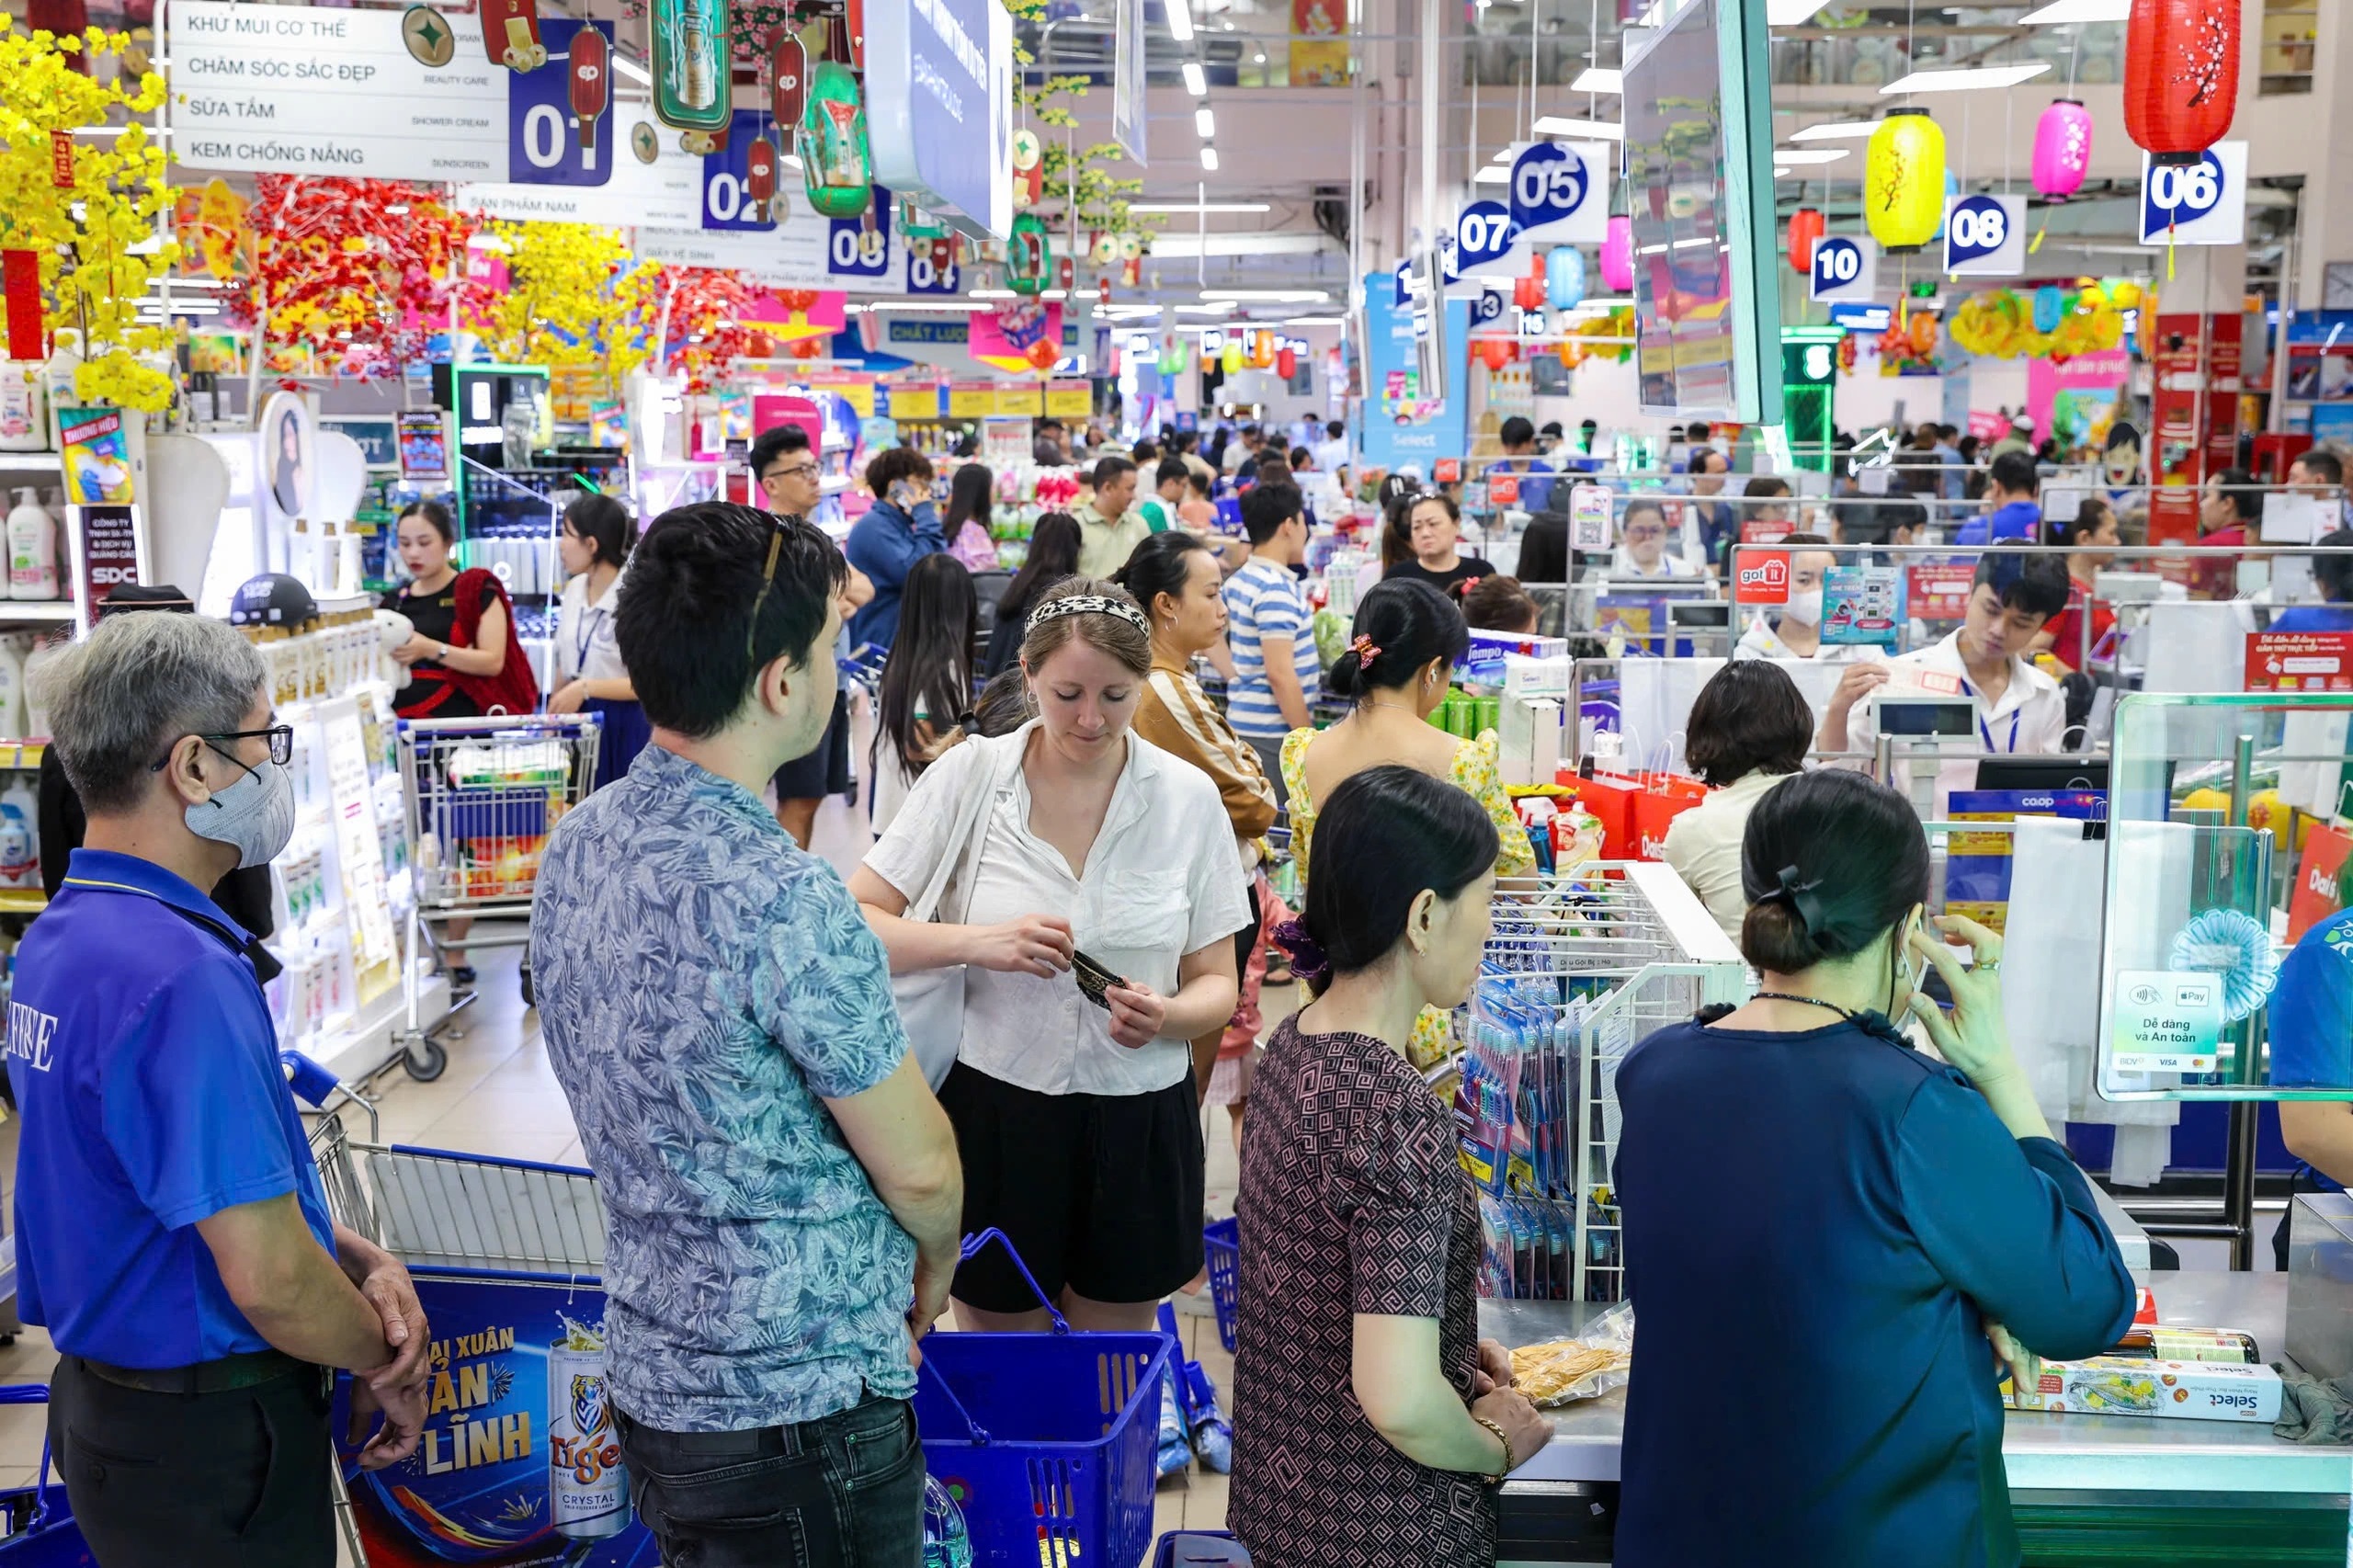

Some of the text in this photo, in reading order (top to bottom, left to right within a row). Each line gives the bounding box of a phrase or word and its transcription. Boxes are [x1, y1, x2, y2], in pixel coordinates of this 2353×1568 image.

[188, 15, 229, 32] KHỬ
[276, 20, 305, 36] CƠ
[189, 57, 375, 82] CHĂM SÓC SẮC ĐẸP
[190, 98, 275, 119] SỮA TẮM
[191, 142, 364, 165] KEM CHỐNG NẮNG
[1516, 160, 1581, 209] 05
[2149, 164, 2219, 210] 06
[1459, 213, 1510, 252] 07
[1951, 208, 2006, 248] 08
[1816, 249, 1857, 281] 10
[1476, 294, 1500, 319] 13
[91, 566, 137, 584] SDC
[1742, 568, 1763, 583] got
[1468, 643, 1502, 661] Tempo
[1641, 834, 1664, 860] Dais
[2188, 992, 2205, 1003] Pay
[2135, 1031, 2196, 1042] và An toàn
[2143, 1017, 2190, 1031] Dễ dàng
[427, 1325, 515, 1366] ẠI XUÂN
[426, 1358, 489, 1415] ẢN
[2209, 1394, 2257, 1409] Select
[423, 1410, 531, 1476] LĨNH
[549, 1433, 621, 1485] Tige
[562, 1493, 615, 1505] CRYSTAL
